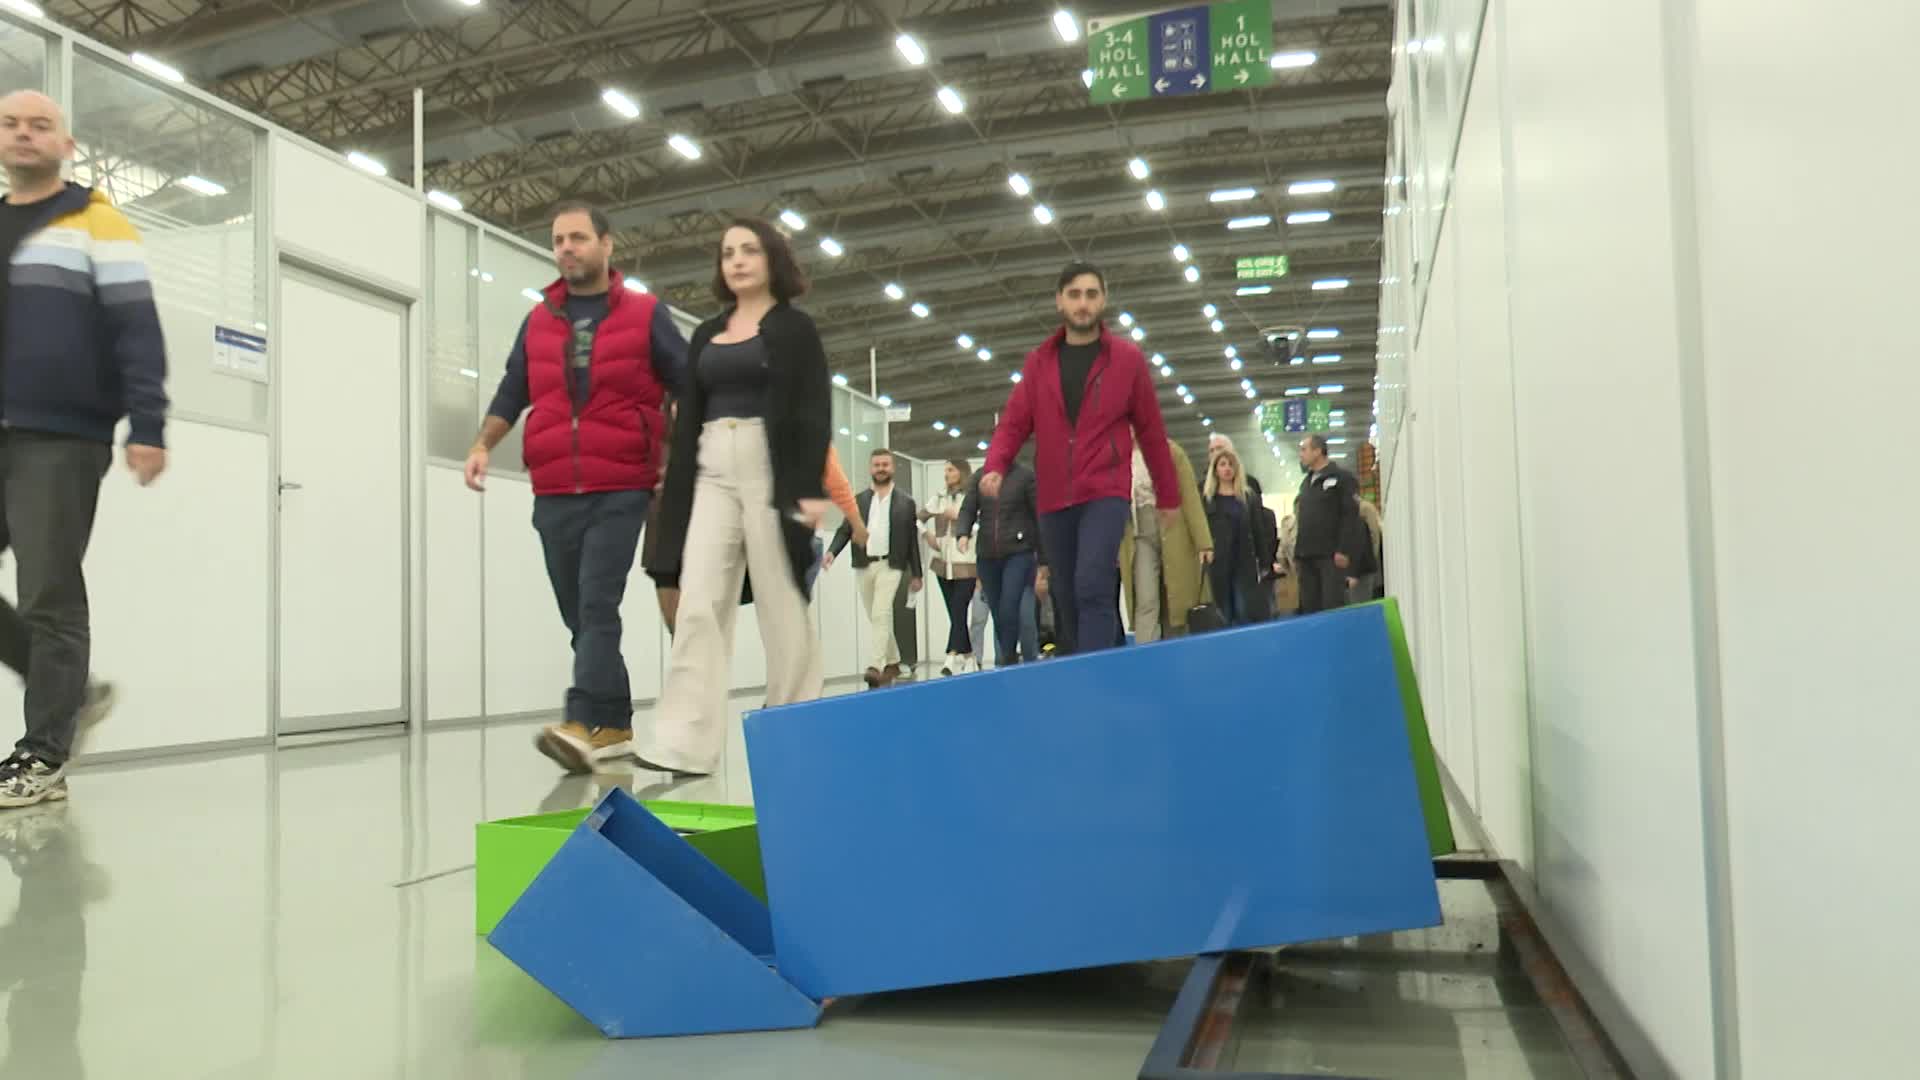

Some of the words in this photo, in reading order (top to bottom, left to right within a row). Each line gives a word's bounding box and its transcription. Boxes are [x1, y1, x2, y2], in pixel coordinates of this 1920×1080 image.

[1236, 15, 1245, 32] 1
[1104, 30, 1133, 48] 3-4
[1221, 32, 1260, 49] HOL
[1099, 47, 1136, 63] HOL
[1214, 48, 1268, 66] HALL
[1095, 63, 1144, 80] HALL
